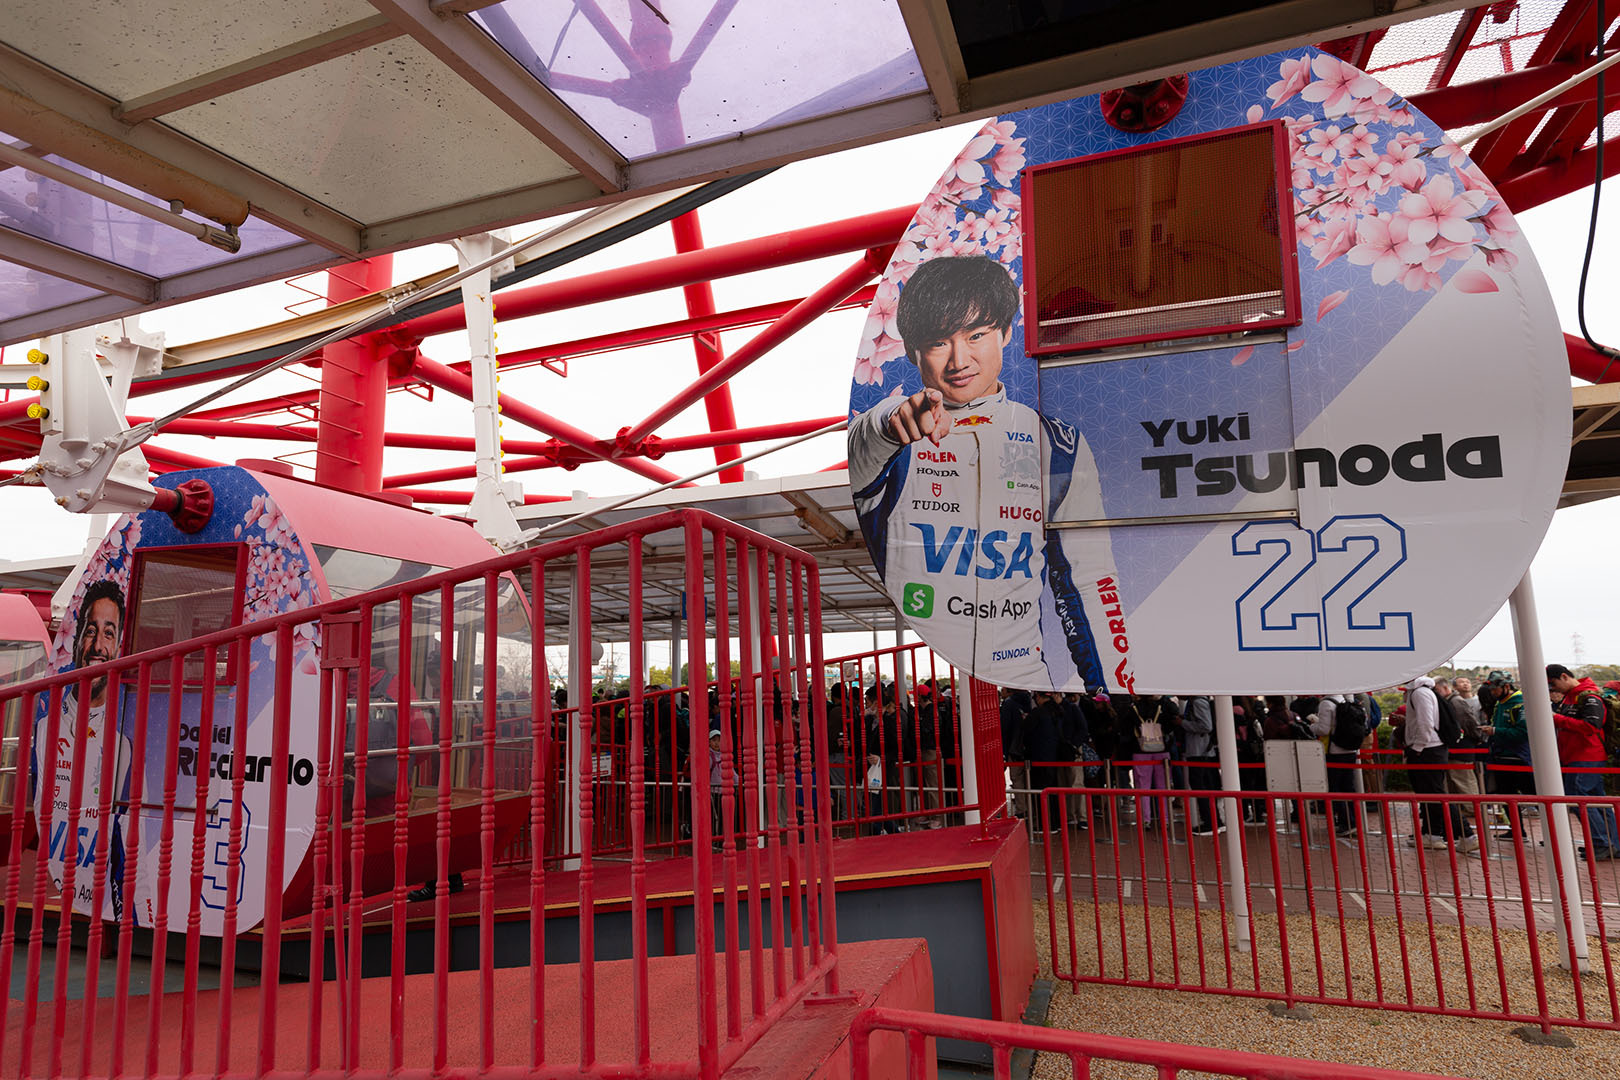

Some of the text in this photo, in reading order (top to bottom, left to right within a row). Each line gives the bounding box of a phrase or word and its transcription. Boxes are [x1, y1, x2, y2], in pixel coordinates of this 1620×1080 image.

[1006, 431, 1034, 444] VISA
[1140, 412, 1250, 447] Yuki
[917, 450, 957, 463] ORLEN
[1141, 433, 1503, 498] Tsunoda
[916, 467, 960, 477] HONDA
[912, 500, 961, 513] TUDOR
[999, 505, 1042, 523] HUGO
[909, 522, 1034, 580] VISA
[1232, 513, 1415, 652] 22
[947, 596, 1032, 621] Cash App
[1096, 576, 1130, 654] ORLEN
[992, 647, 1030, 661] TSUNODA
[179, 723, 232, 745] Daiel
[55, 774, 71, 782] NDA
